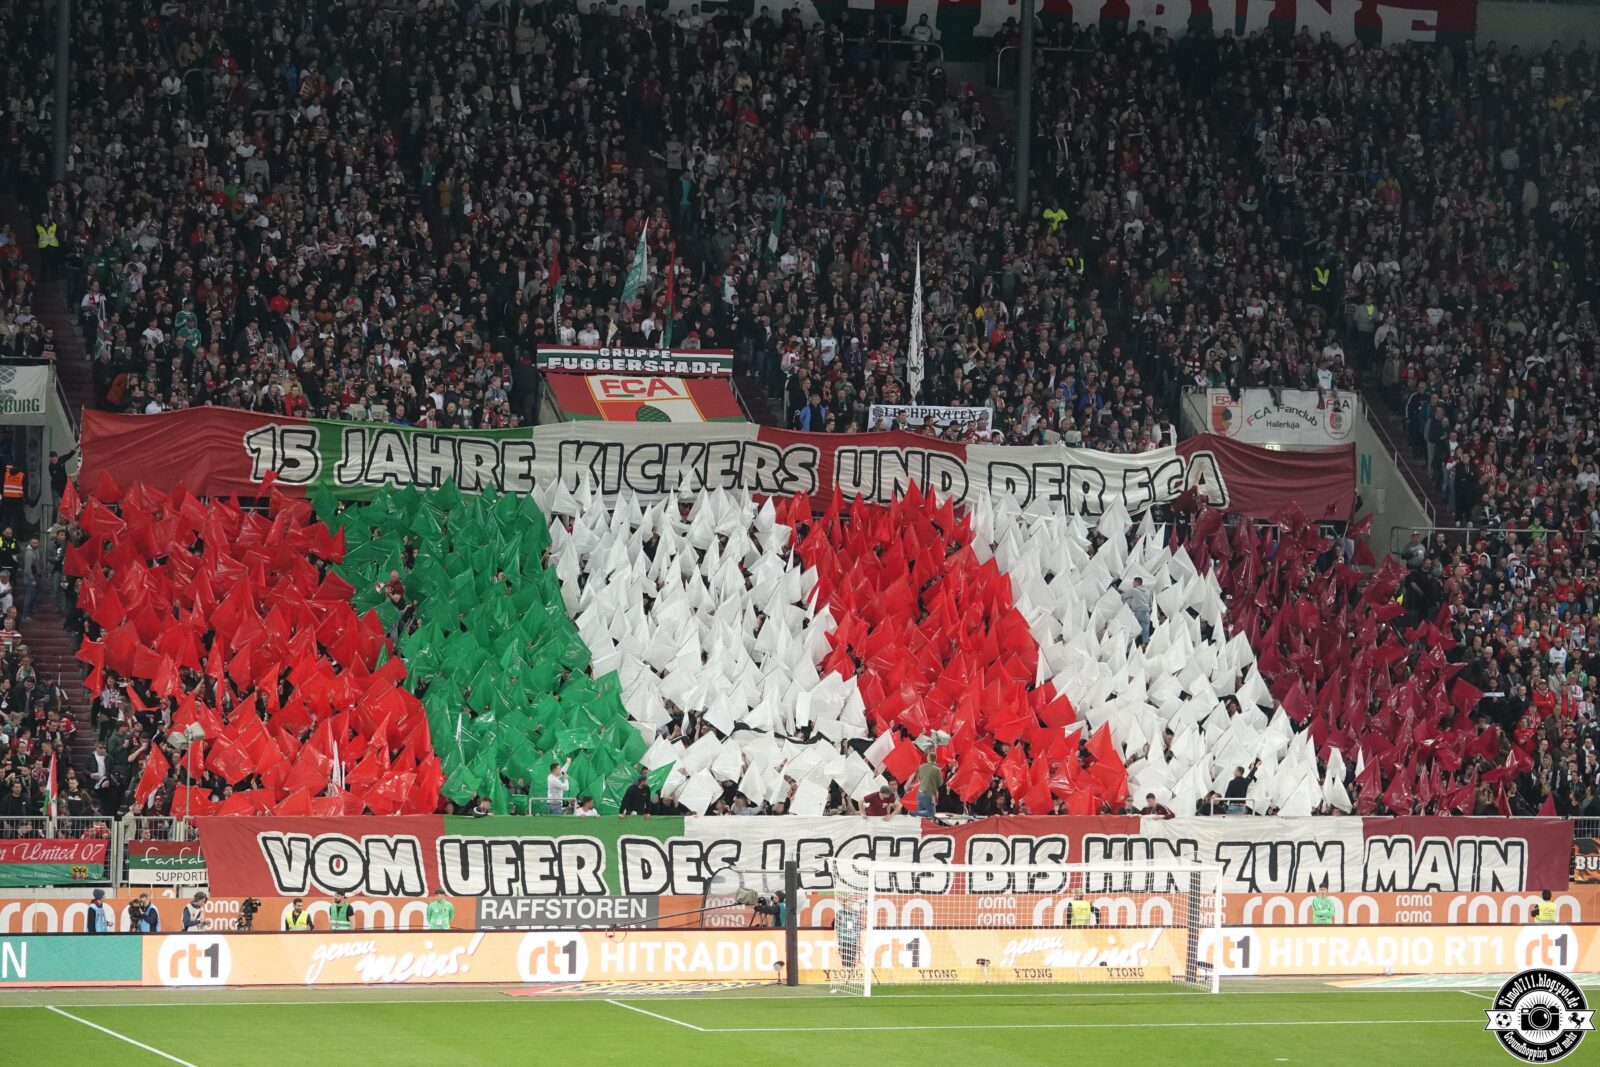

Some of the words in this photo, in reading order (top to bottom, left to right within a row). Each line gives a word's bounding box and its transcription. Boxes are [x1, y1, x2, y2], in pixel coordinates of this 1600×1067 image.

[599, 348, 672, 359] GRUPPE
[547, 357, 721, 375] FUGGERSTADT
[600, 377, 680, 397] FCA
[1325, 397, 1350, 410] FA
[1246, 406, 1272, 427] FCA
[1276, 403, 1318, 427] Fanclub
[244, 425, 321, 483] 15
[335, 427, 537, 494] JAHRE
[558, 439, 818, 496] KICKERS
[834, 447, 970, 506] UND
[987, 461, 1106, 516] DER
[13, 842, 75, 861] United
[81, 843, 105, 861] 07
[259, 835, 427, 897] VOM
[438, 837, 610, 897] UFER
[620, 837, 742, 896] DES
[761, 834, 953, 895] LECHS
[967, 835, 1067, 895] BIS
[1083, 836, 1199, 894] HIN
[1214, 840, 1346, 893] ZUM
[1362, 837, 1526, 893] MAIN
[1575, 856, 1600, 870] BU
[155, 871, 207, 882] SUPPORT
[203, 900, 239, 914] oma
[480, 898, 648, 920] RAFFSTOREN
[977, 896, 1017, 909] roma
[1396, 894, 1432, 907] roma
[977, 912, 1017, 926] roma
[1396, 910, 1432, 923] roma
[355, 932, 485, 983] meins!
[529, 940, 577, 975] rt1
[602, 940, 779, 974] HITRADIO
[874, 937, 920, 968] rt1
[1269, 936, 1433, 968] HITRADIO
[1444, 935, 1504, 967] RT1
[1524, 933, 1568, 967] rt1
[169, 943, 219, 978] rt1
[306, 940, 377, 984] genau
[918, 969, 958, 979] YTONG
[1015, 968, 1053, 979] YTONG
[1107, 967, 1144, 978] YTONG
